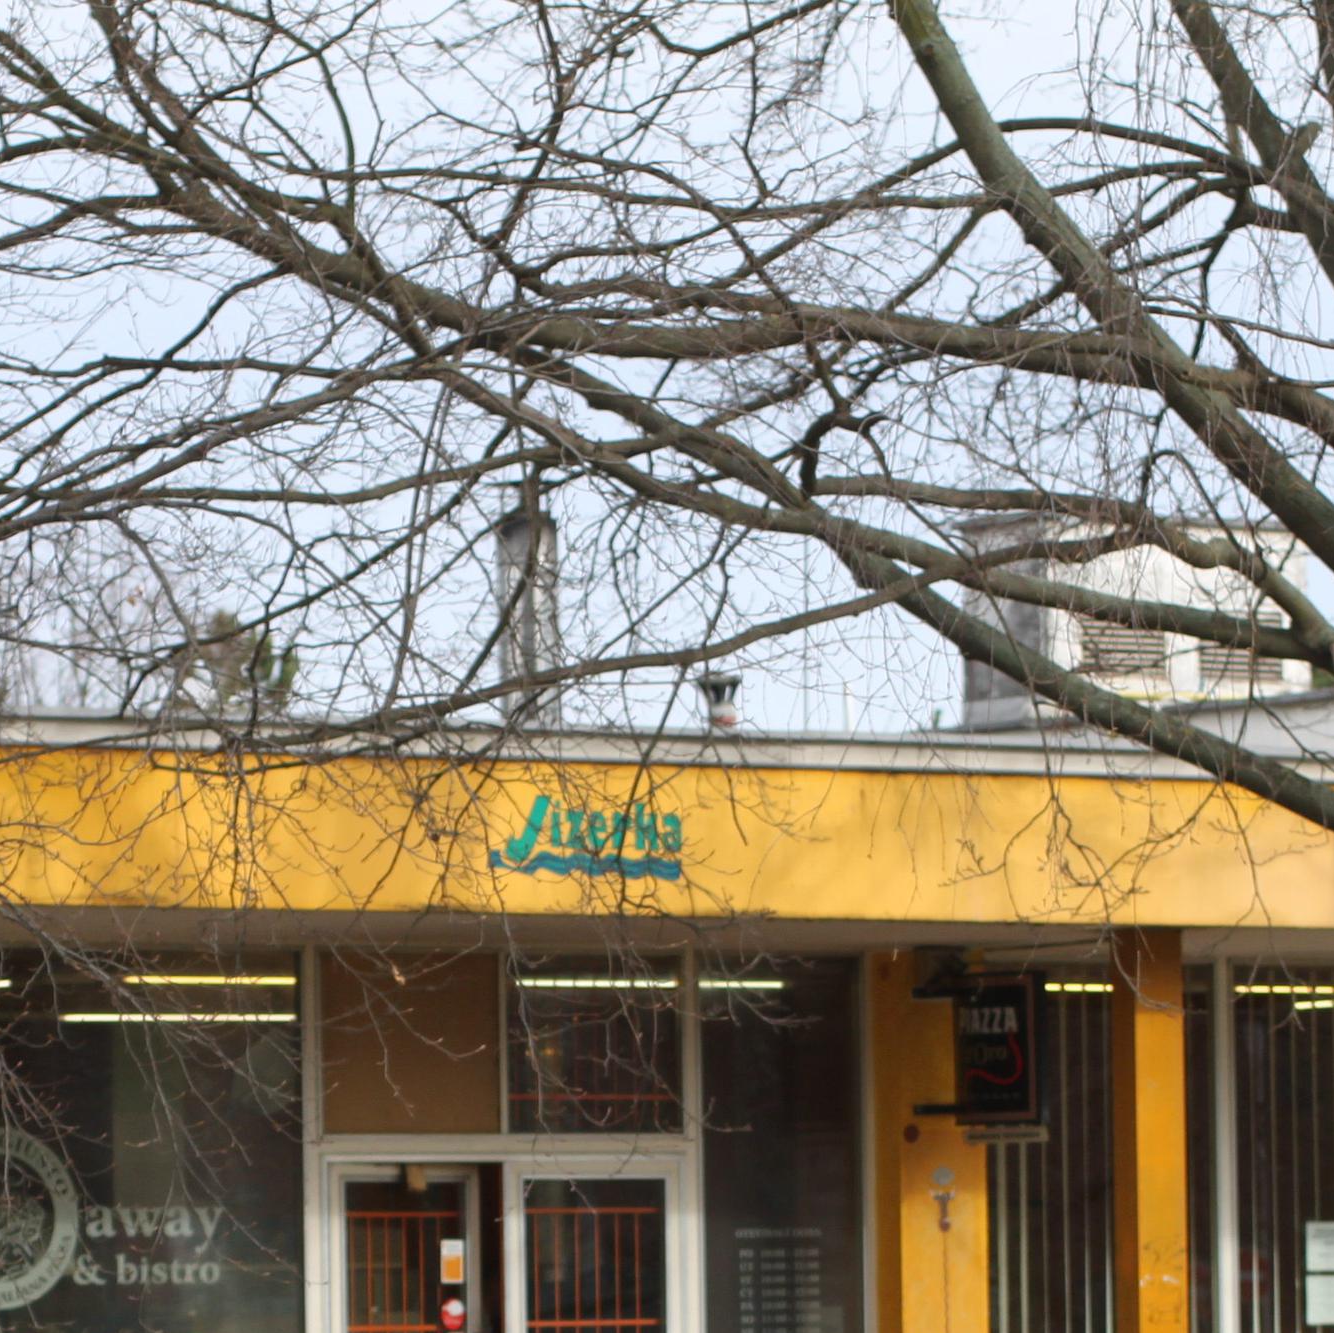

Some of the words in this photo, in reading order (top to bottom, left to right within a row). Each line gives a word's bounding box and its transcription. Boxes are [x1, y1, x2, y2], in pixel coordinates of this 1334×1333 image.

[86, 1205, 224, 1256] away
[72, 1254, 107, 1286] &
[115, 1253, 221, 1285] bistro
